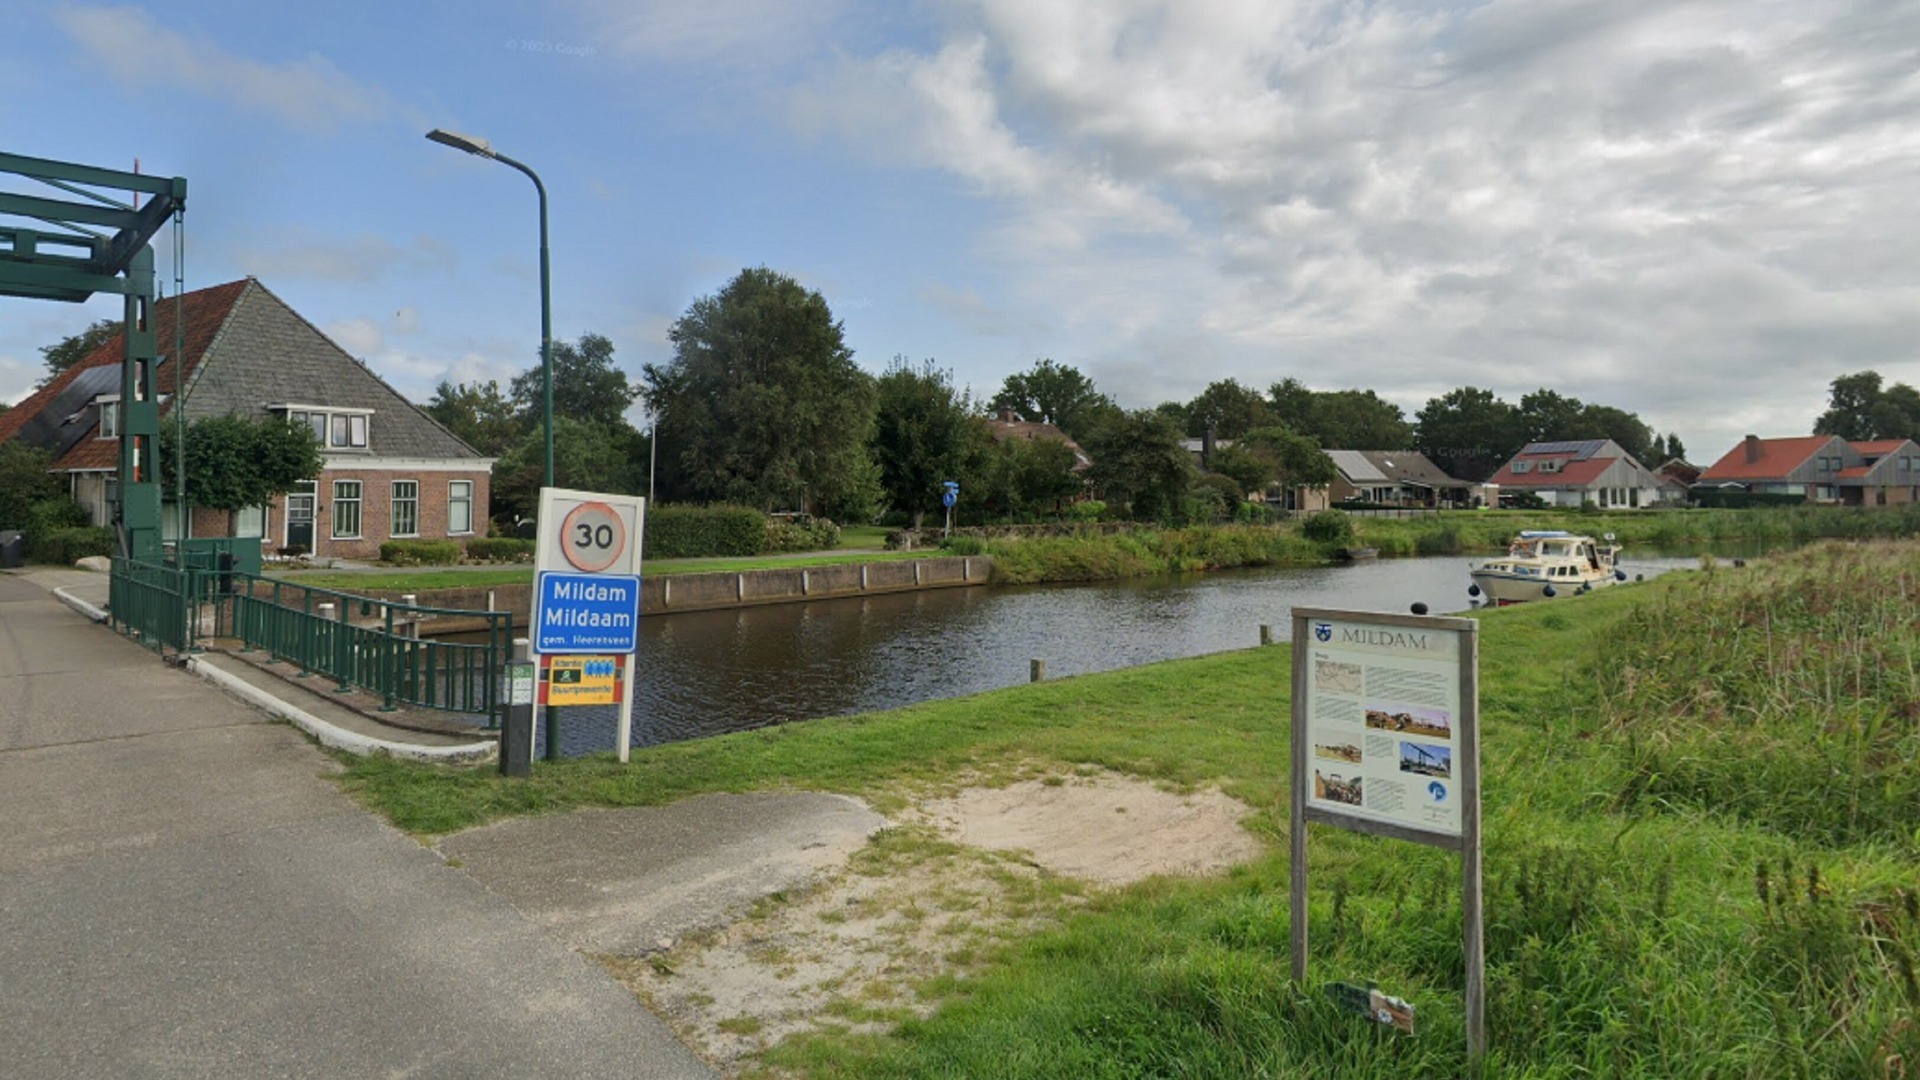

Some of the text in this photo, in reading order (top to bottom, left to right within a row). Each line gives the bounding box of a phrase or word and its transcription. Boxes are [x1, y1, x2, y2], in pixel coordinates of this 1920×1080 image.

[575, 524, 613, 549] 30
[554, 581, 626, 601] Mildam
[546, 607, 630, 627] Mildaam
[573, 635, 630, 645] Heerenveen
[1342, 627, 1428, 649] MILDAM
